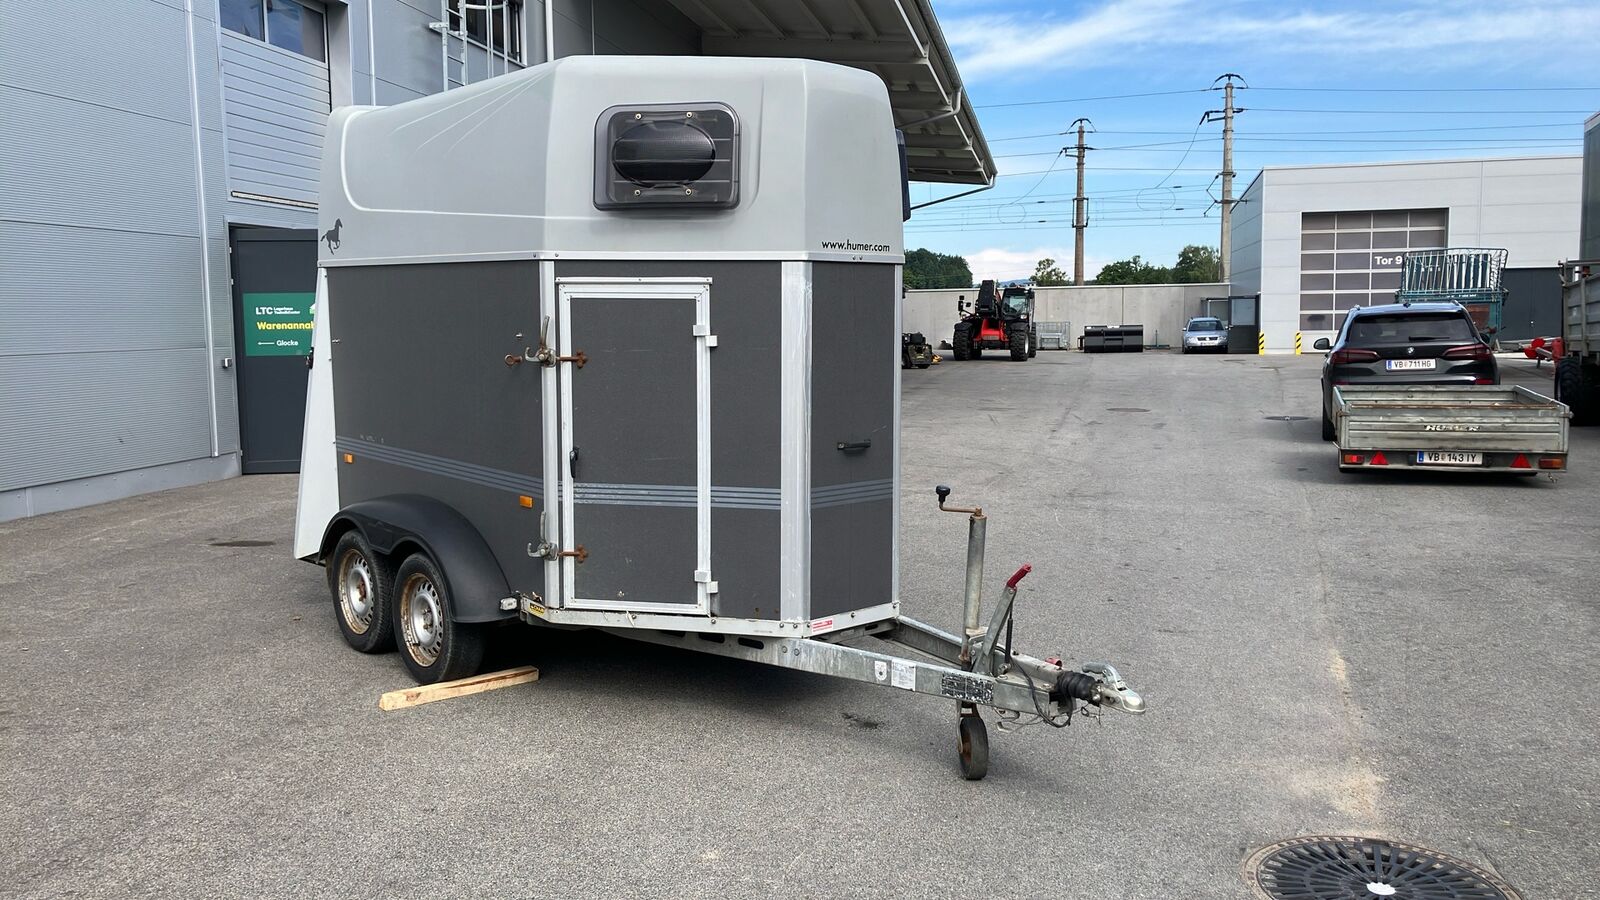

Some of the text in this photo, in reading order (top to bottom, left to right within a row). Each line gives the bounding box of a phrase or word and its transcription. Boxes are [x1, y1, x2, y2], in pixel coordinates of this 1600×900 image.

[821, 239, 890, 252] www.humer.com
[1374, 255, 1403, 265] Tor 9
[255, 306, 274, 315] LTC
[1428, 452, 1440, 462] VB
